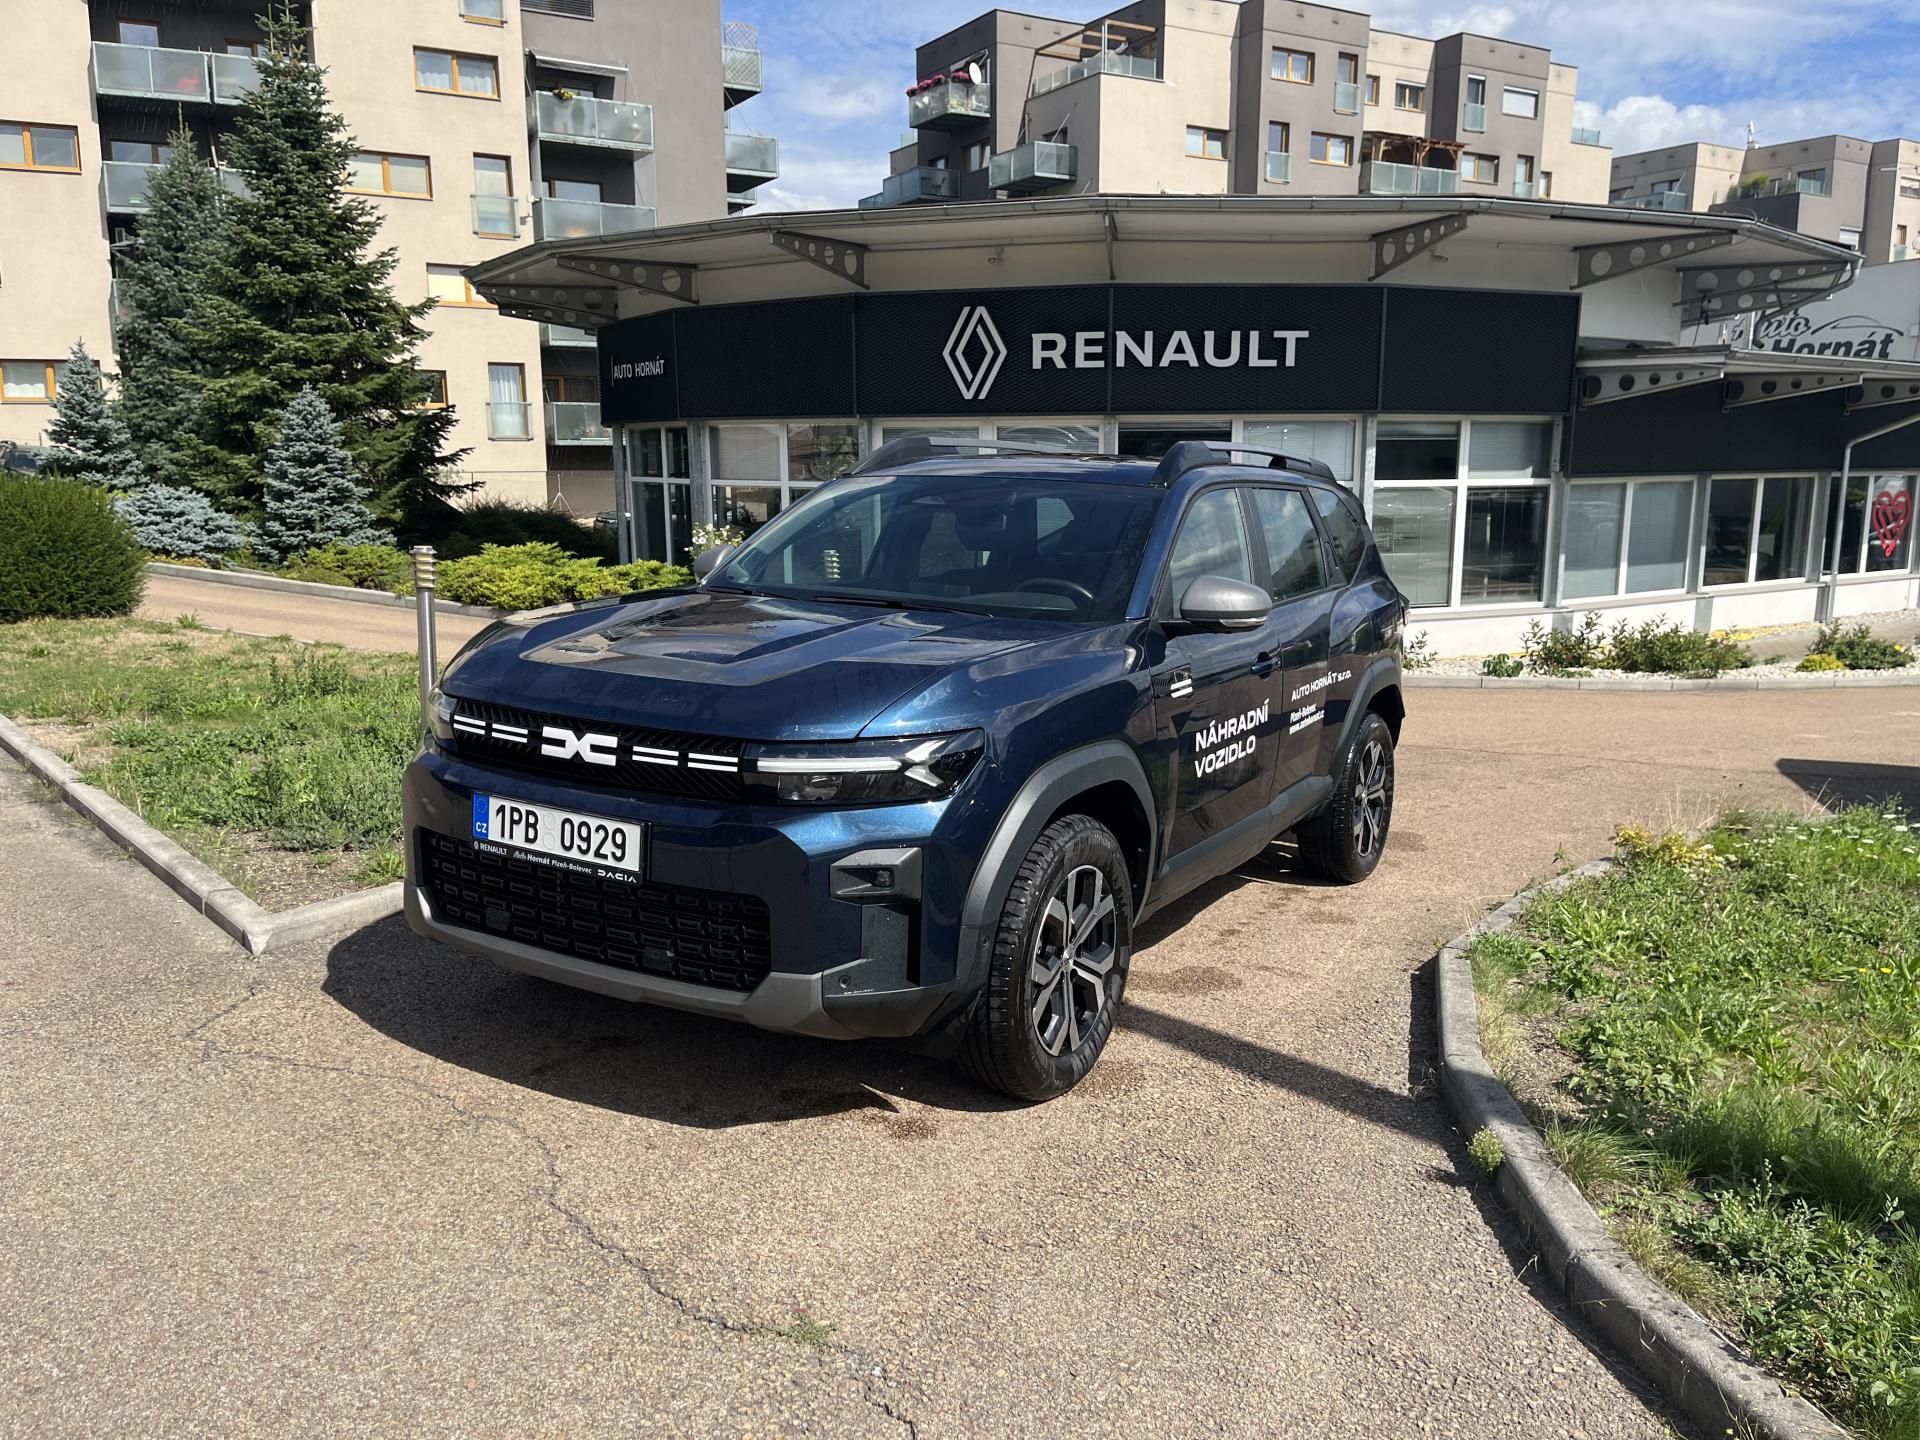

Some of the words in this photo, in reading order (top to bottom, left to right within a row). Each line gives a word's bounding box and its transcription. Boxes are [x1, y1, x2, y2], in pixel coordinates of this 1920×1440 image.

[1031, 329, 1310, 369] RENAULT
[613, 364, 633, 379] AUTO
[634, 355, 665, 377] HORNÁT
[1291, 684, 1310, 702] AUTO
[1310, 670, 1338, 693] HORNÁT
[1194, 698, 1270, 752] NÁHRADNÍ
[1194, 735, 1256, 778] VOZIDLO
[475, 821, 487, 833] CZ
[495, 804, 539, 844] 1PB
[560, 817, 627, 863] 0929
[480, 843, 508, 856] RENAULT
[527, 853, 550, 865] Hornát
[597, 869, 637, 883] DACIA
